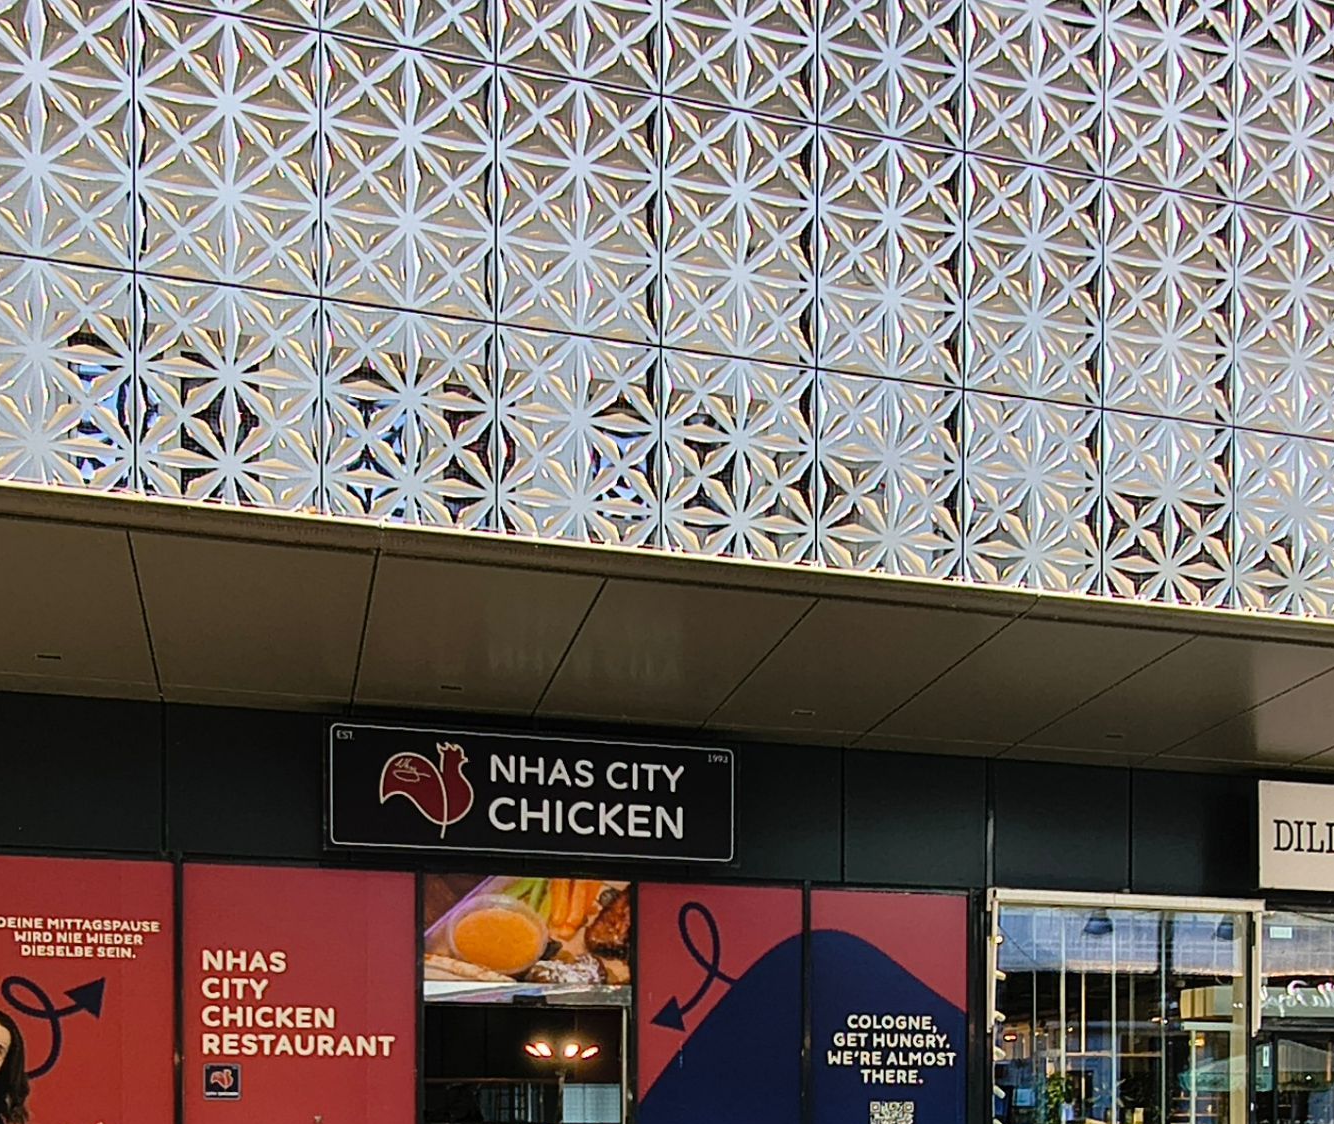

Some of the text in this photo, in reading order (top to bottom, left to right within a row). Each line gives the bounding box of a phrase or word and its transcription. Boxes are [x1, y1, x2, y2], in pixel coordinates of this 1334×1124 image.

[707, 753, 729, 764] 1993
[490, 754, 685, 793] NHAS CITY
[488, 796, 684, 839] CHICKEN
[47, 917, 161, 933] MITTAGSPAUSE
[13, 931, 144, 945] WIRD NIE WIEDER
[20, 944, 137, 959] DIESELBE SEIN.
[201, 949, 287, 973] NHAS
[201, 977, 269, 1000] CITY
[201, 1005, 336, 1029] CHICKEN
[847, 1014, 938, 1034] COLOGNE,
[201, 1033, 396, 1057] RESTAURANT
[833, 1032, 951, 1049] GET HUNGRY.
[827, 1050, 957, 1067] WE'RE ALMOST
[860, 1069, 924, 1085] THERE.
